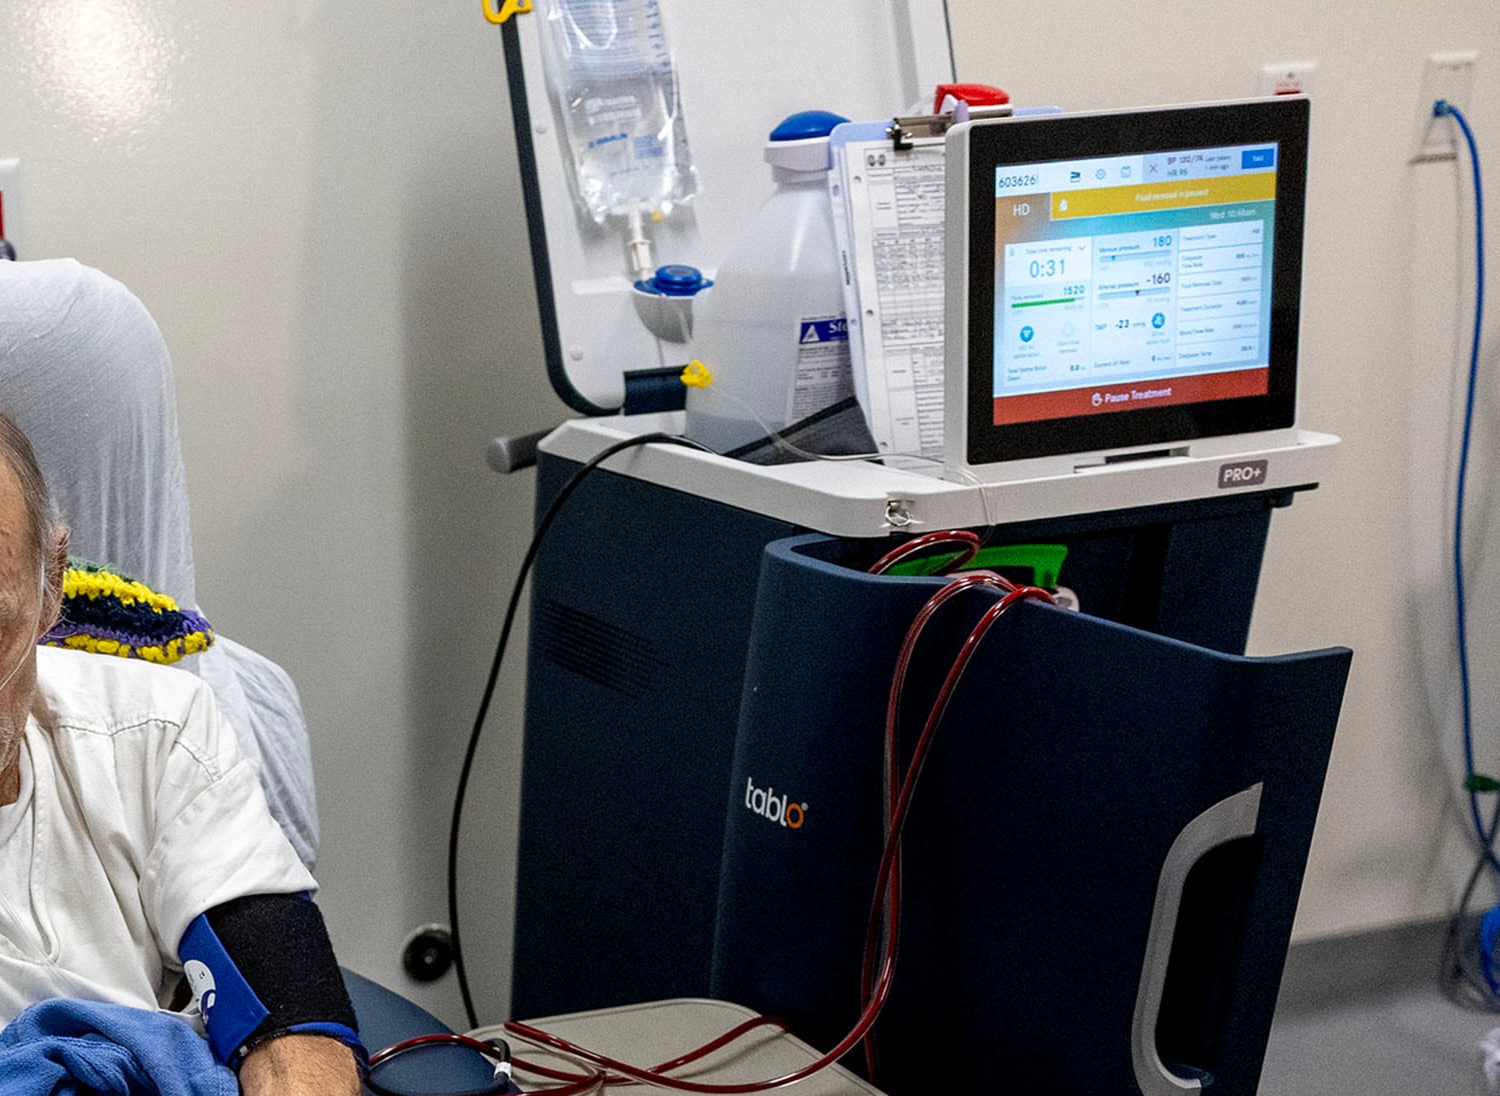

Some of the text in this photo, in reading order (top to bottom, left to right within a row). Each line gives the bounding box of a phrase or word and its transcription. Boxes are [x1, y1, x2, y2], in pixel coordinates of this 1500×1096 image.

[998, 175, 1036, 189] 603626
[1012, 203, 1031, 216] HD
[1153, 234, 1173, 247] 180
[1029, 258, 1065, 278] 0:31
[1146, 272, 1171, 284] -160
[1063, 284, 1085, 295] 1520
[1104, 387, 1172, 403] Pause Treatment
[1223, 466, 1262, 482] PRO+
